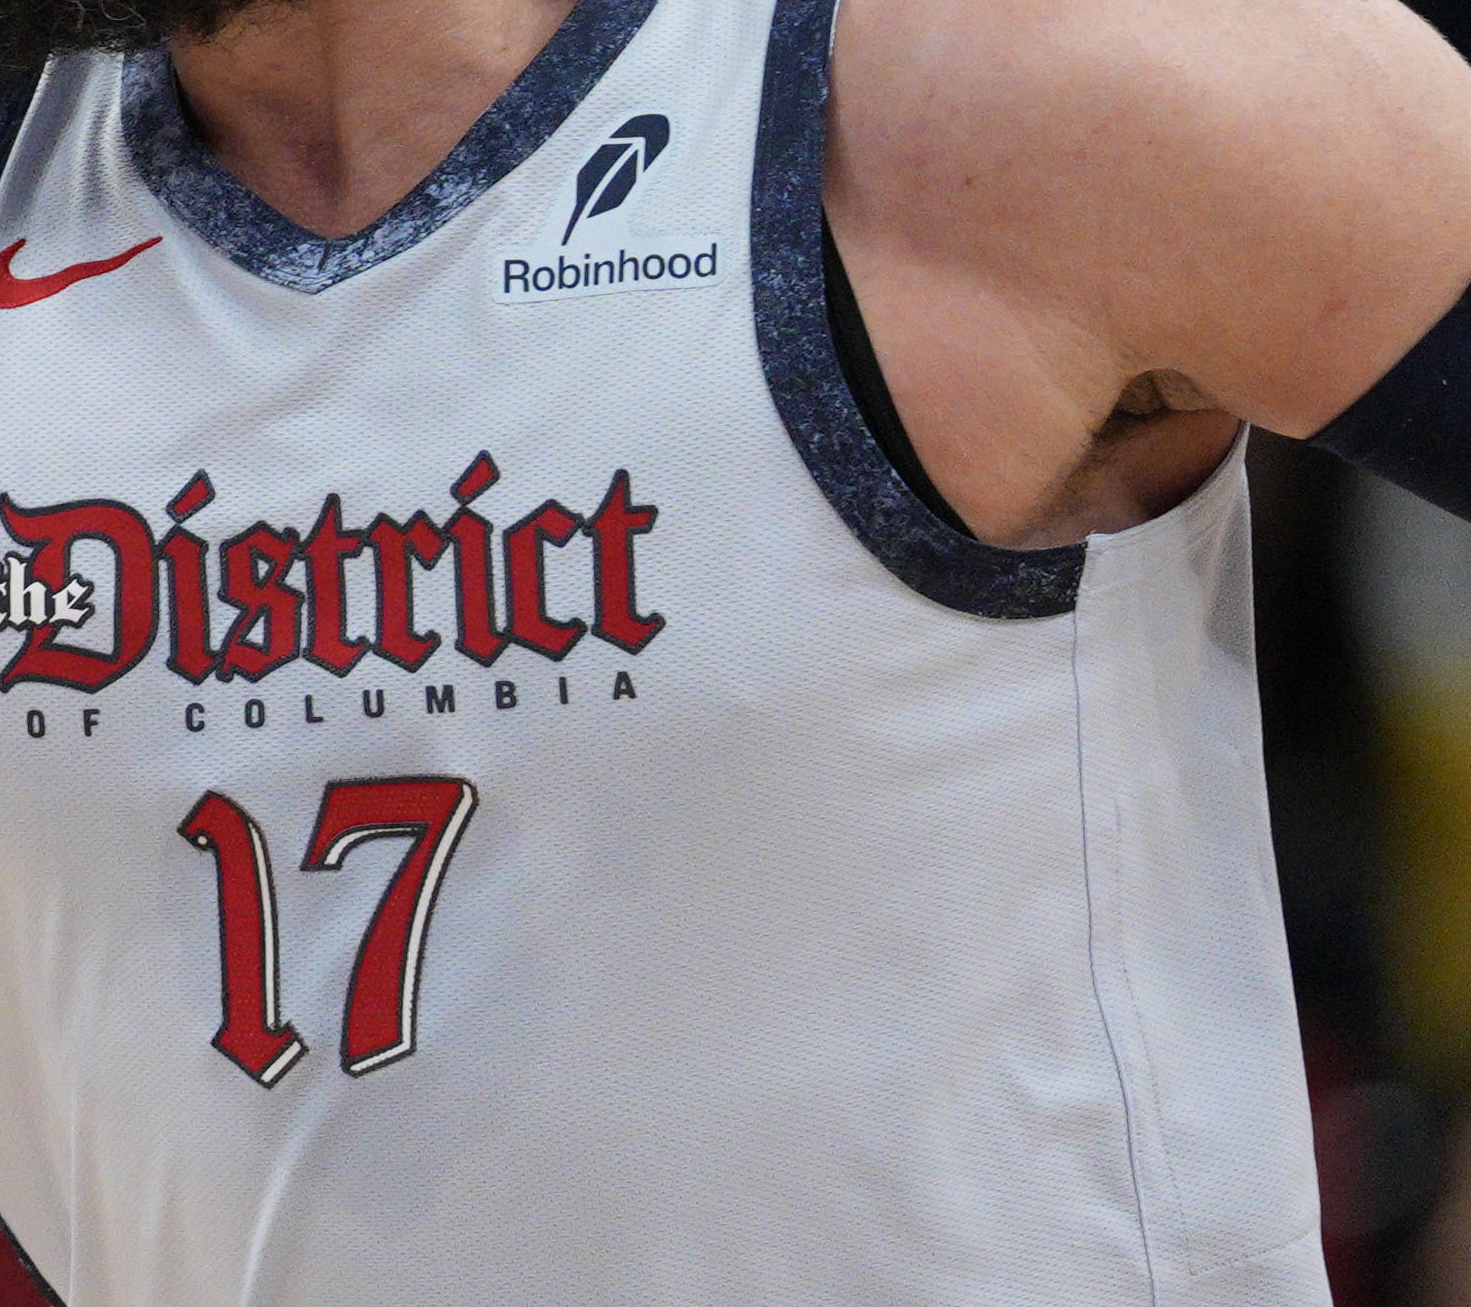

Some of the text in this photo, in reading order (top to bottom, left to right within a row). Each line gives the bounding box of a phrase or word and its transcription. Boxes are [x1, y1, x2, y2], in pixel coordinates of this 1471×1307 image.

[503, 242, 718, 294] Robinhood
[26, 670, 638, 738] OF COLUMBIA
[177, 773, 479, 1090] 17
